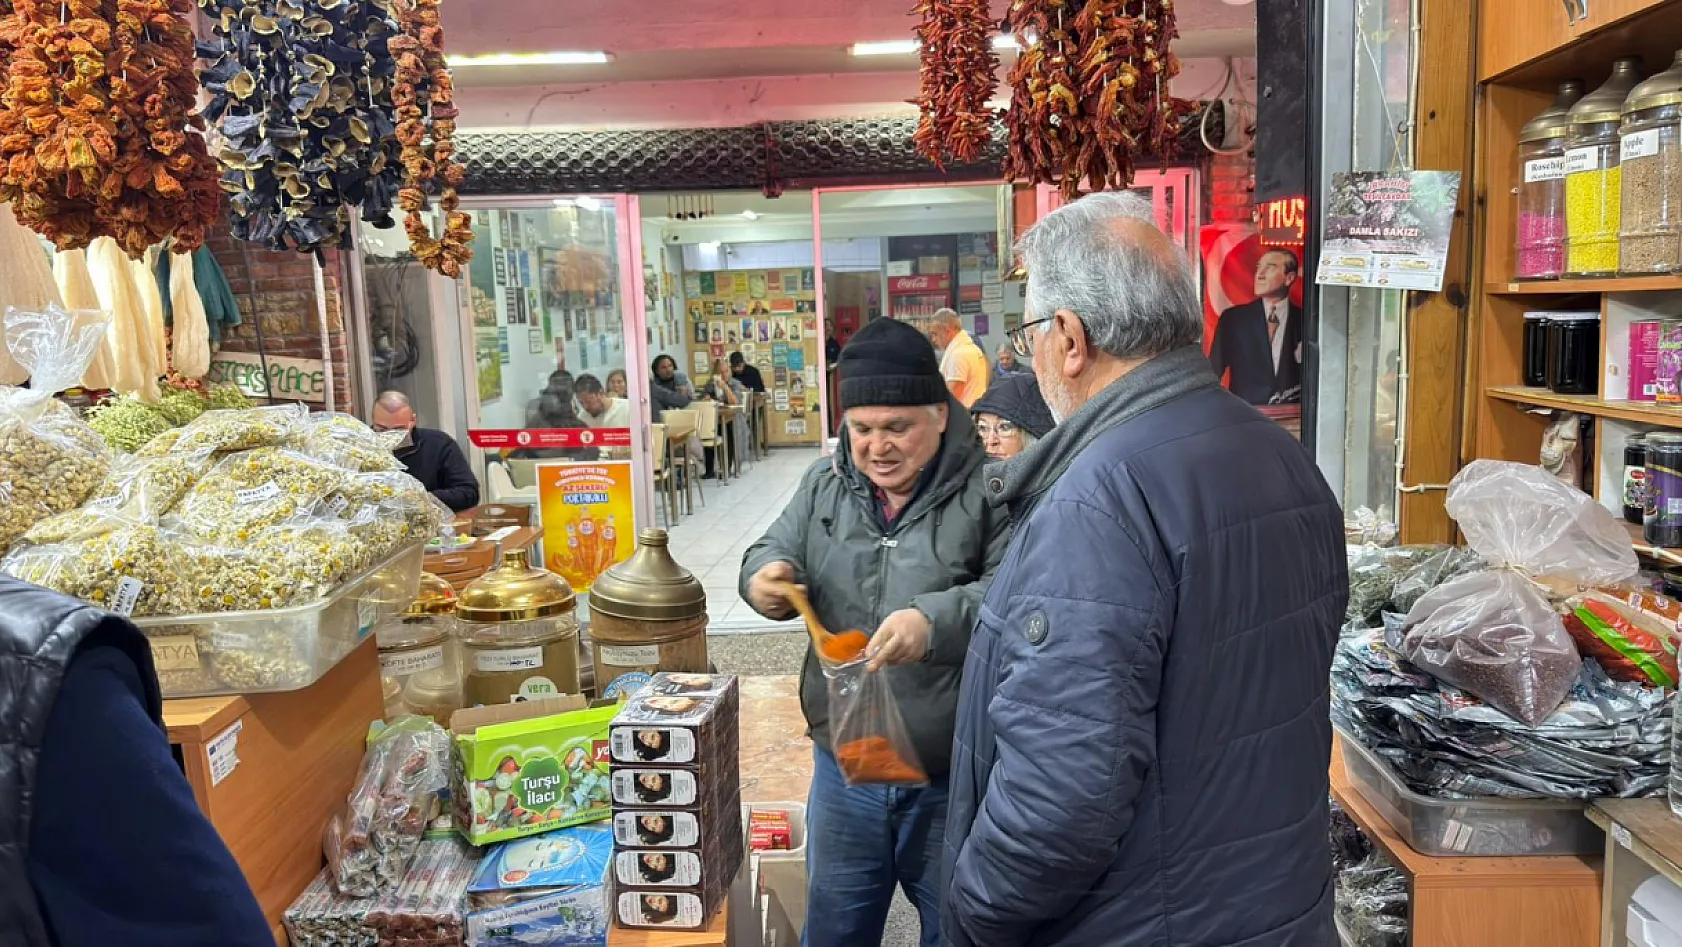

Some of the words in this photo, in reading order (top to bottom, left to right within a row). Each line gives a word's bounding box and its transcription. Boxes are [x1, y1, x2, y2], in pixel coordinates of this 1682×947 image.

[1531, 161, 1565, 172] Rosehip
[1349, 227, 1381, 236] DAMLA
[1383, 227, 1418, 237] SAKIZI
[269, 362, 324, 396] PLACE
[527, 684, 551, 693] vera
[521, 773, 561, 791] Turşu
